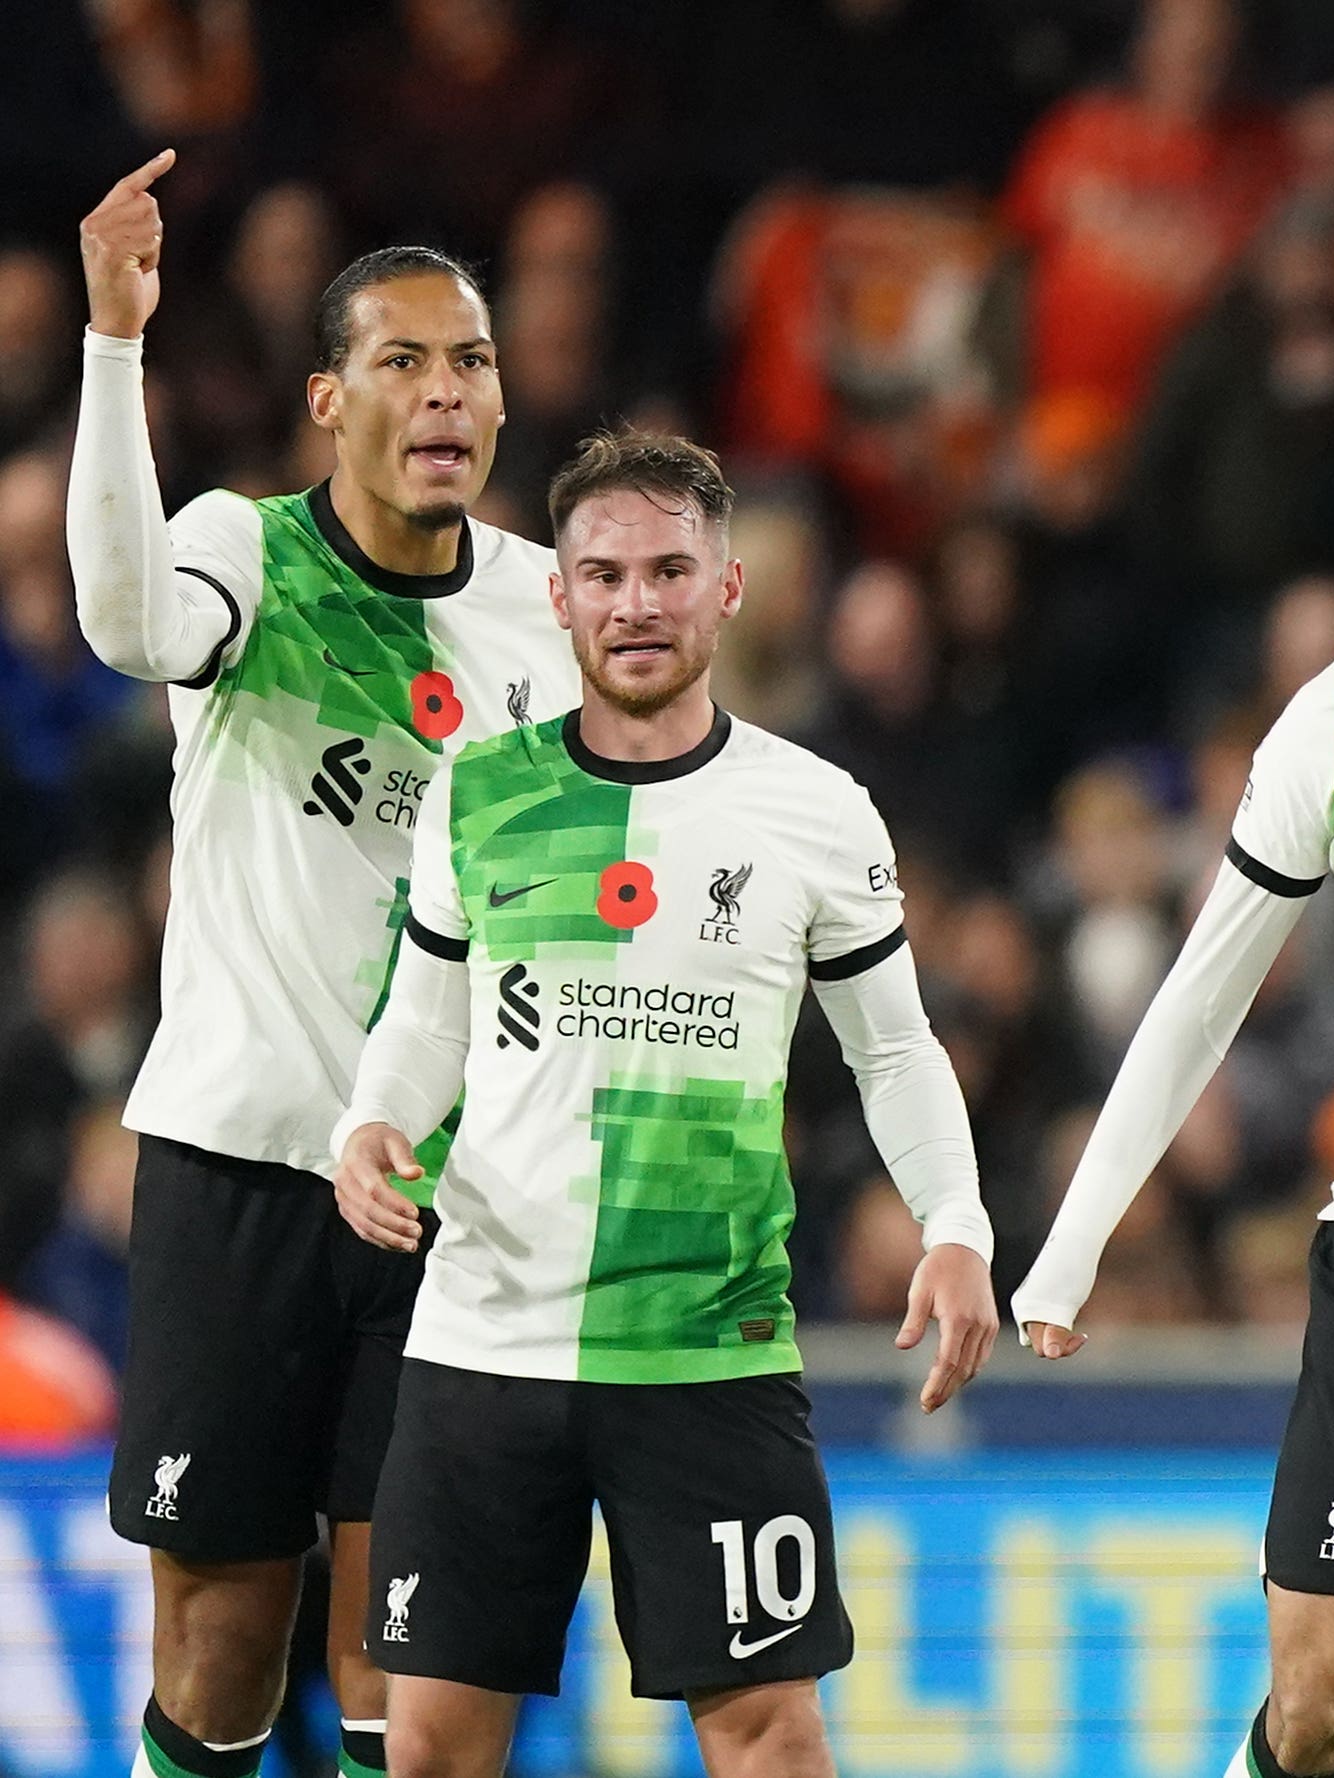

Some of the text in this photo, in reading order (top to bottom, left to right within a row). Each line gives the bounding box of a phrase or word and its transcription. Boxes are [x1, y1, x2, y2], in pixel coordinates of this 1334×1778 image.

[868, 863, 897, 892] Ex
[559, 978, 734, 1019] standard
[556, 1009, 740, 1050] chartered
[710, 1514, 817, 1624] 10
